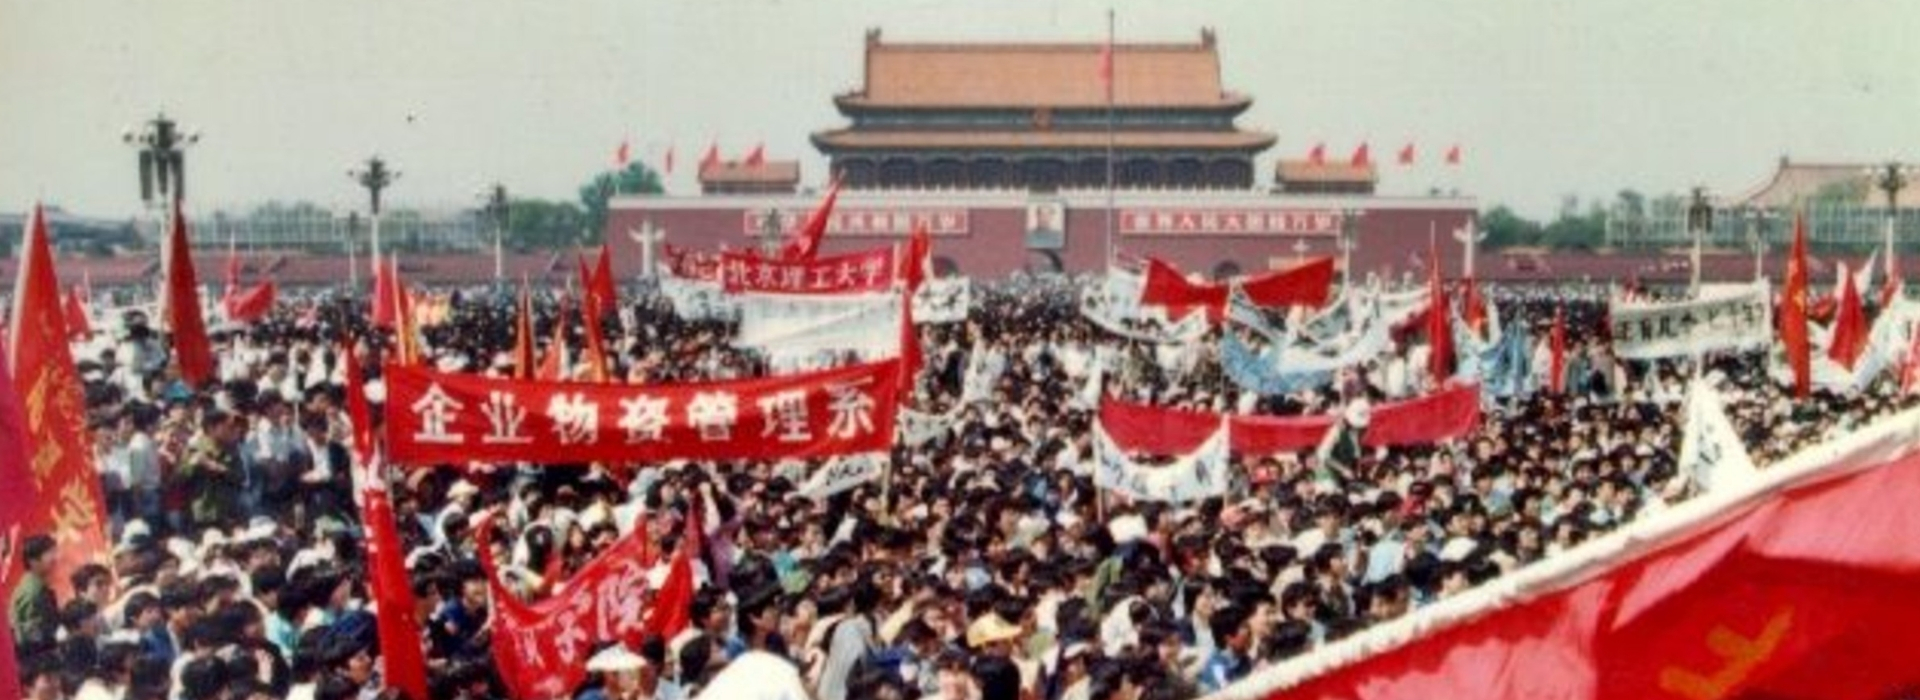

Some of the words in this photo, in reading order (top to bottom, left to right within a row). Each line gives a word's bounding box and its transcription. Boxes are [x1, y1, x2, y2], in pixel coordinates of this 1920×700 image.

[725, 254, 884, 289] 北京理工大学
[411, 375, 876, 445] 企业物资管理系
